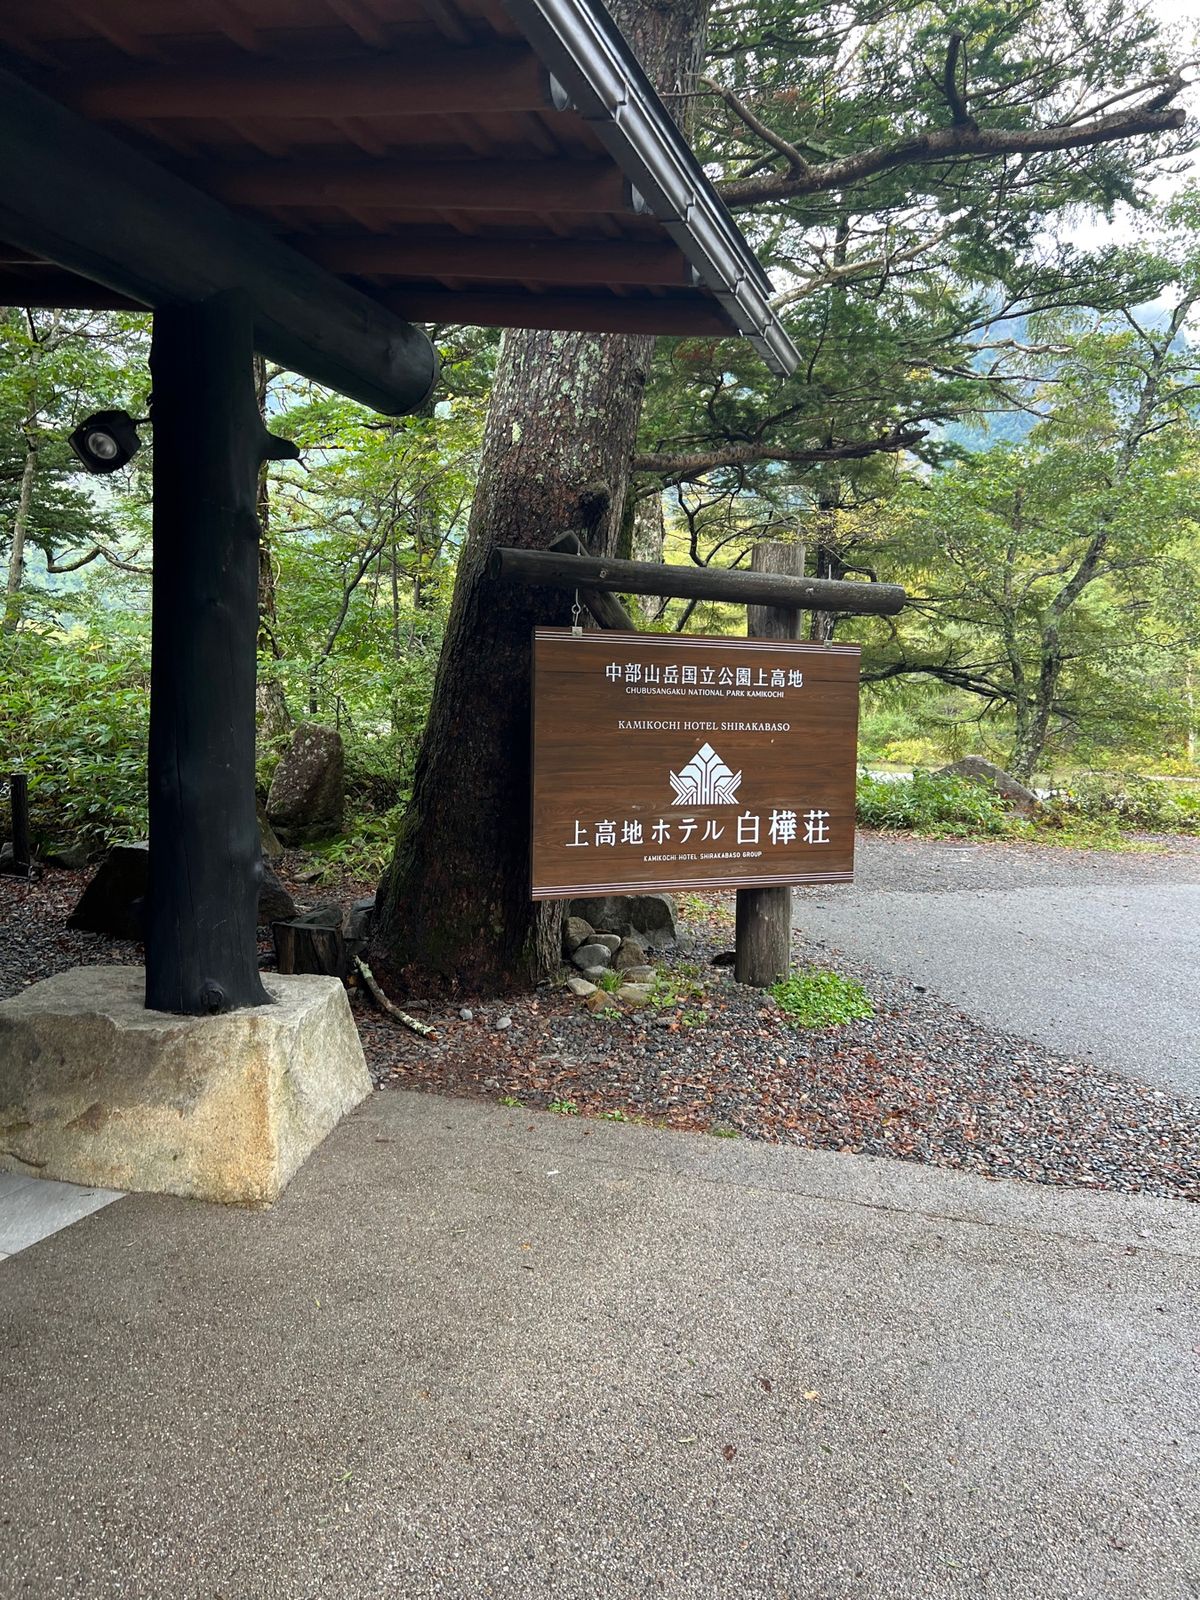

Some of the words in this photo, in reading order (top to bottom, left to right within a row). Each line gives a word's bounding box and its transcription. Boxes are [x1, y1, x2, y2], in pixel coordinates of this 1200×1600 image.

[605, 662, 804, 687] 中部山岳国立公園上高地
[625, 687, 687, 695] CHUBUSANGAKU
[687, 688, 725, 697] NATIONAL
[746, 690, 785, 698] KAMIKOCHI
[618, 720, 681, 730] KAMIKOCHI
[683, 721, 719, 731] HOTEL
[720, 721, 791, 732] SHIRAKABASO
[643, 854, 677, 862] KAMIKOCHI
[678, 853, 698, 861] HOTEL
[699, 851, 741, 860] SHIRAKABASO
[742, 850, 763, 858] GROUP
